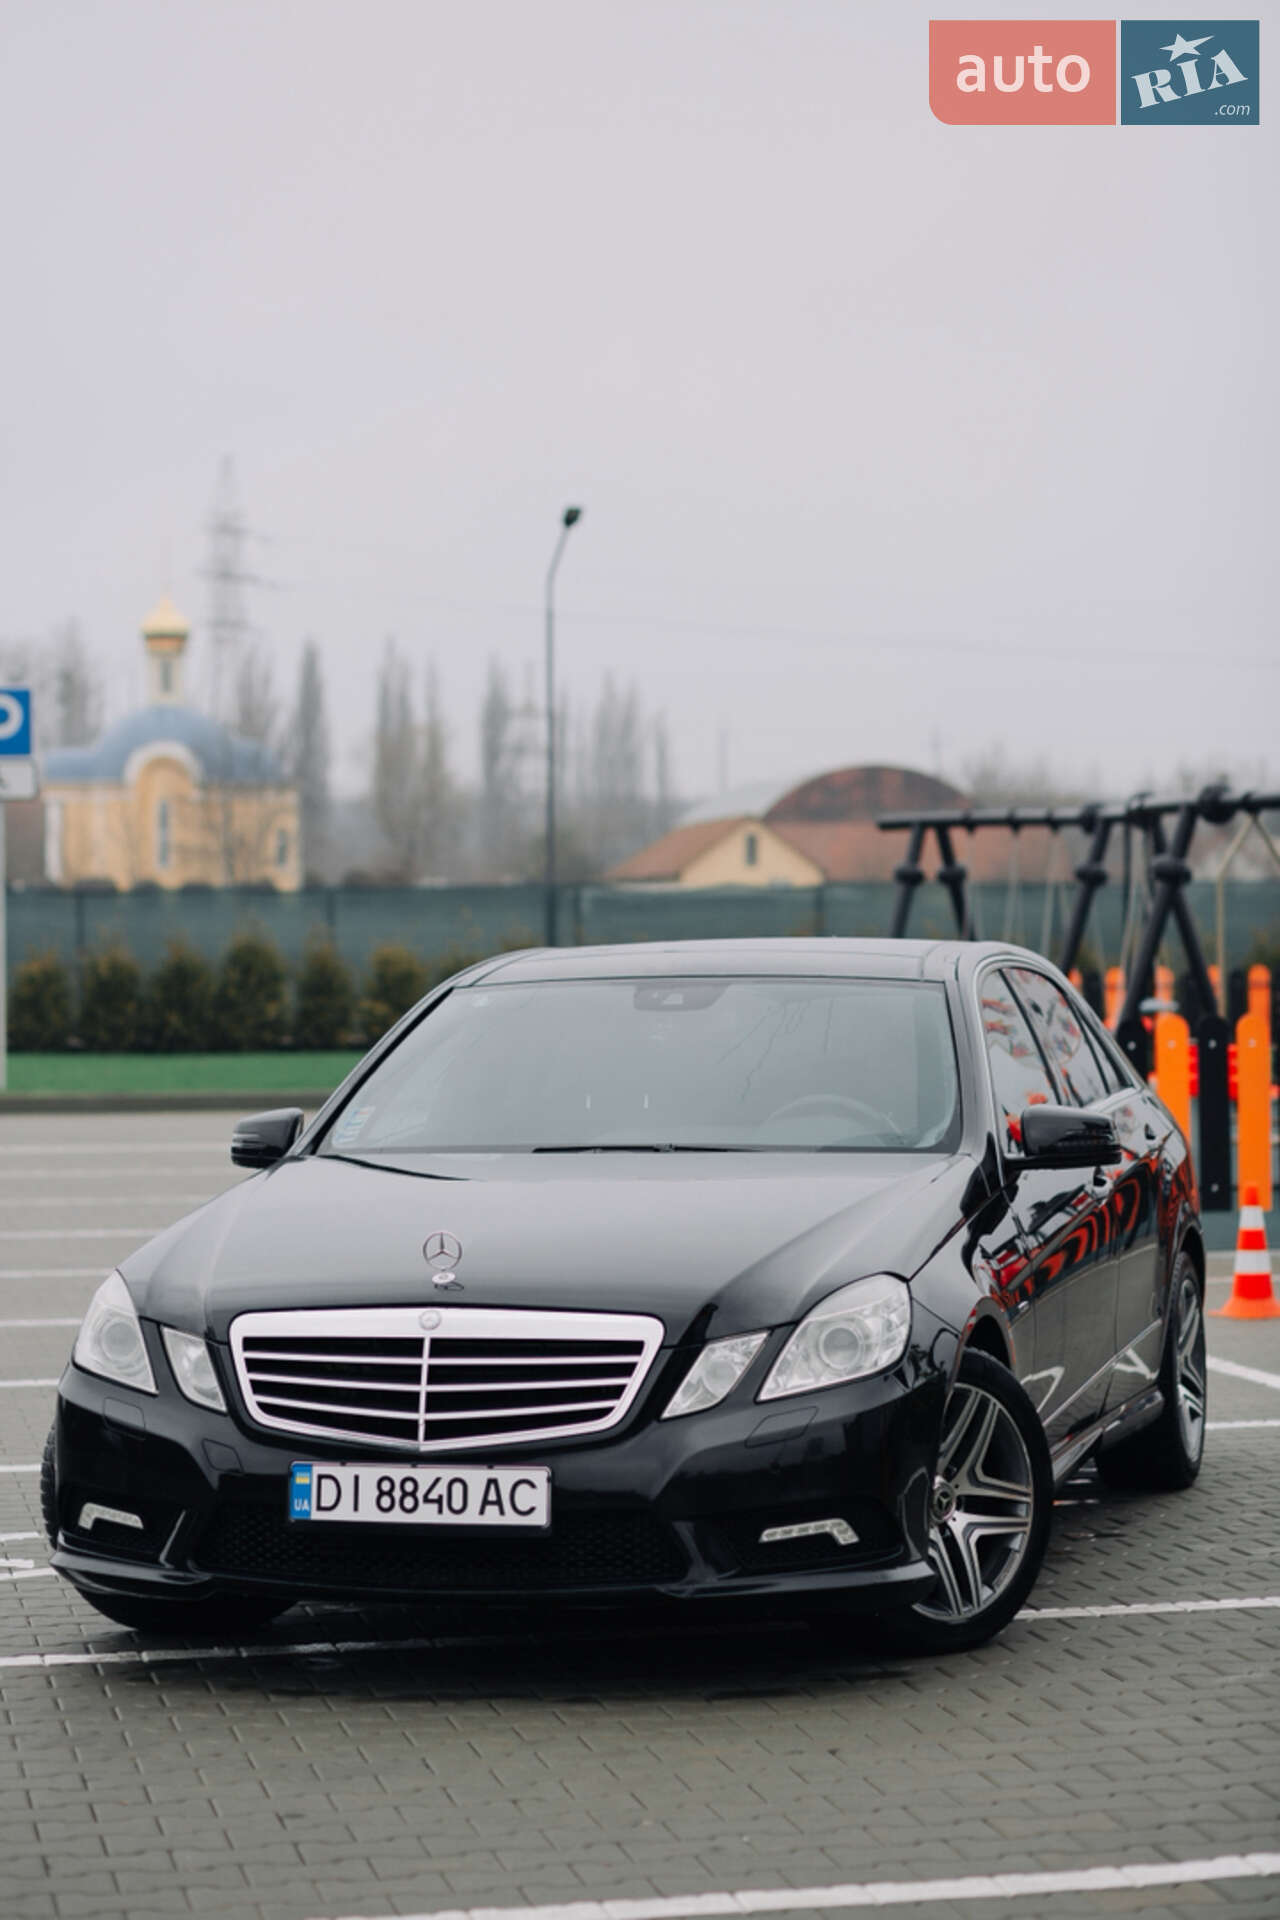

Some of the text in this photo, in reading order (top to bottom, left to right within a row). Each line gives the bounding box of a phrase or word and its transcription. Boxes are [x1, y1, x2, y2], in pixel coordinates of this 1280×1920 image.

[294, 1499, 309, 1511] UA
[315, 1474, 537, 1516] DI 8840 AC
